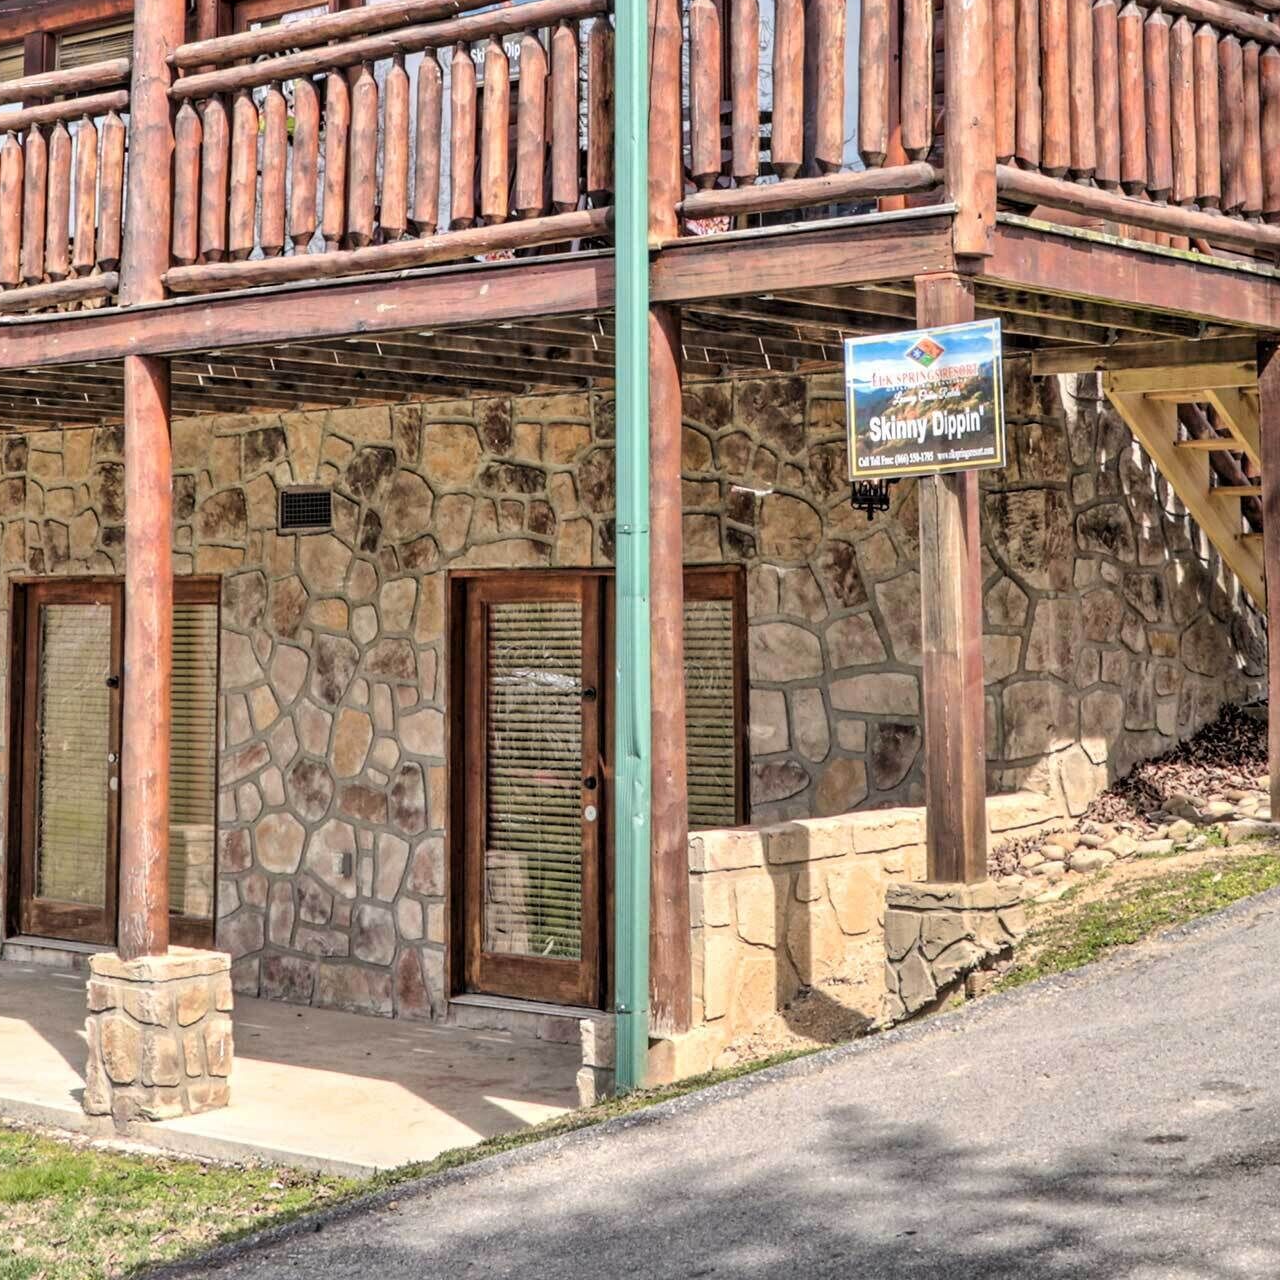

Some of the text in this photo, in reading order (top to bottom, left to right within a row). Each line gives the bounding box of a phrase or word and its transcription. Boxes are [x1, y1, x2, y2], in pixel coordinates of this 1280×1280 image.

[872, 372, 893, 387] ELK
[896, 367, 940, 384] SPRINGS
[941, 363, 977, 380] RESORT
[869, 404, 984, 444] Skinny Dippin'
